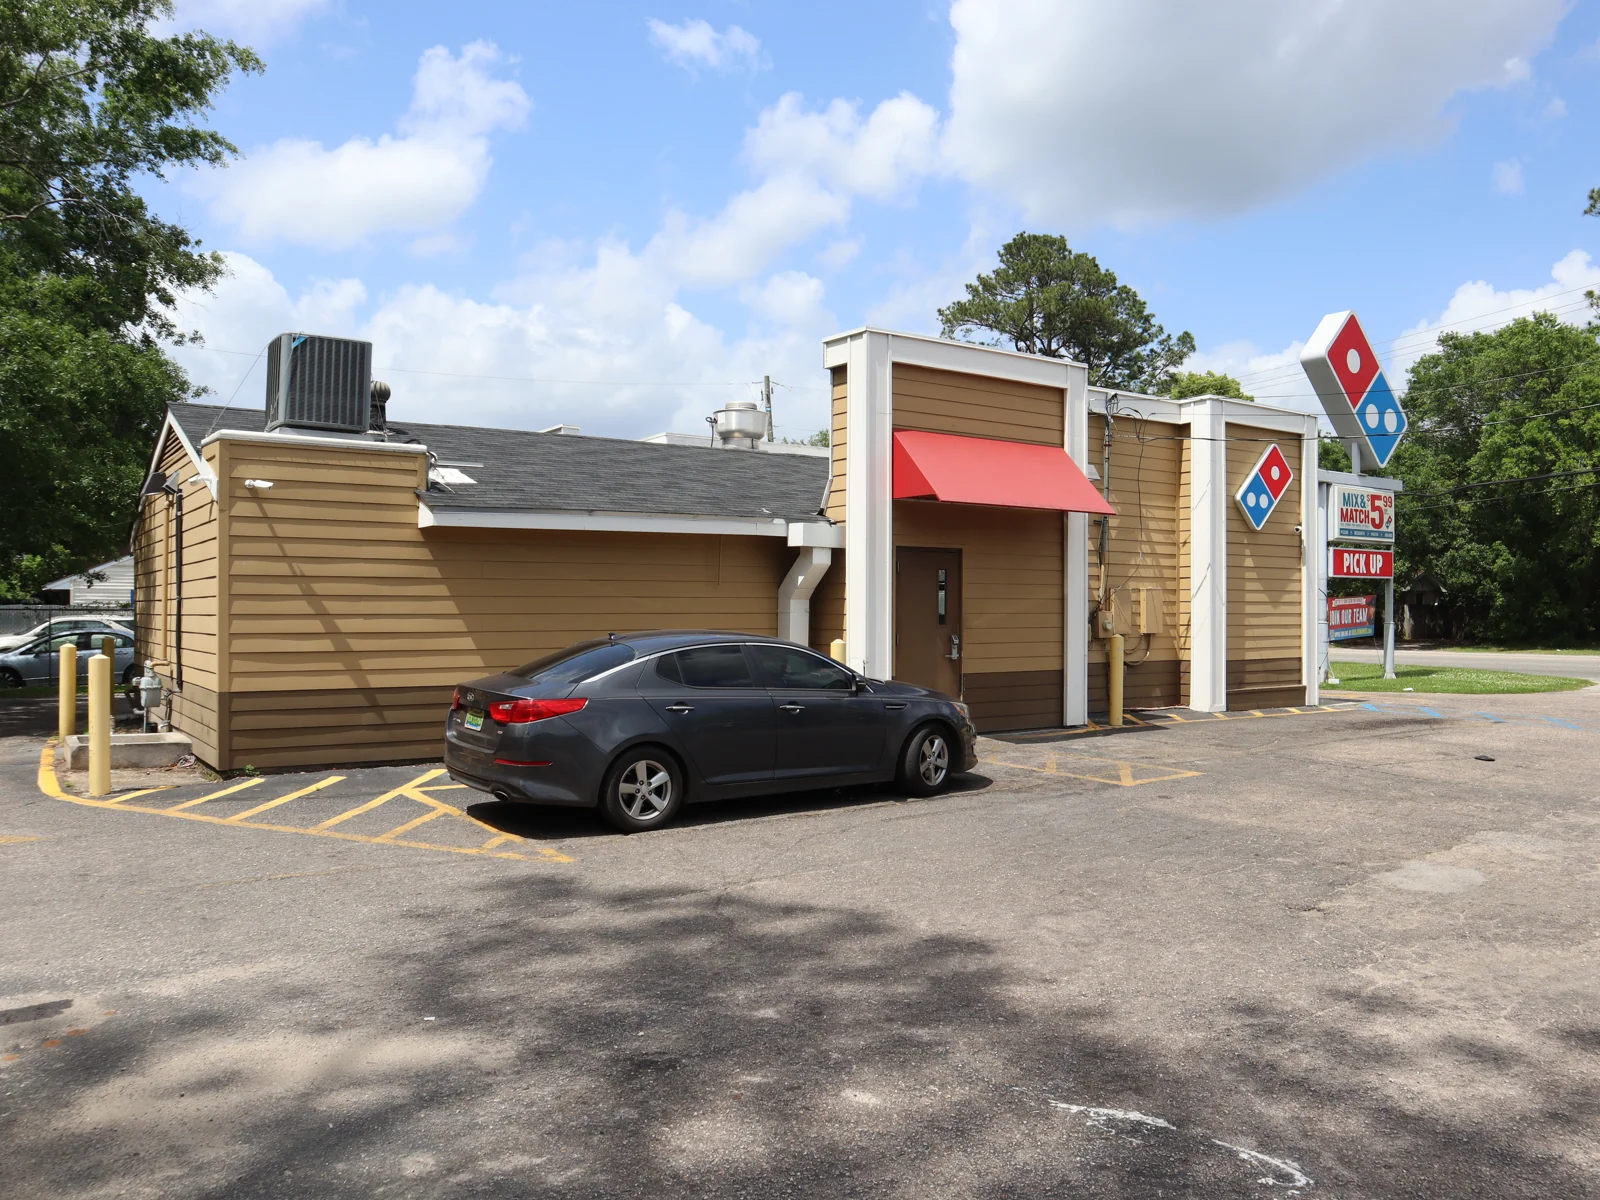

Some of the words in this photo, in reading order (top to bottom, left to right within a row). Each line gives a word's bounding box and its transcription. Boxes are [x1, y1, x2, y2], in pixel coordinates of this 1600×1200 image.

[1341, 508, 1369, 524] MATCH
[1344, 553, 1366, 573] PICK
[1370, 554, 1382, 574] UP
[1342, 609, 1351, 624] OUR
[1354, 608, 1368, 623] TEAM
